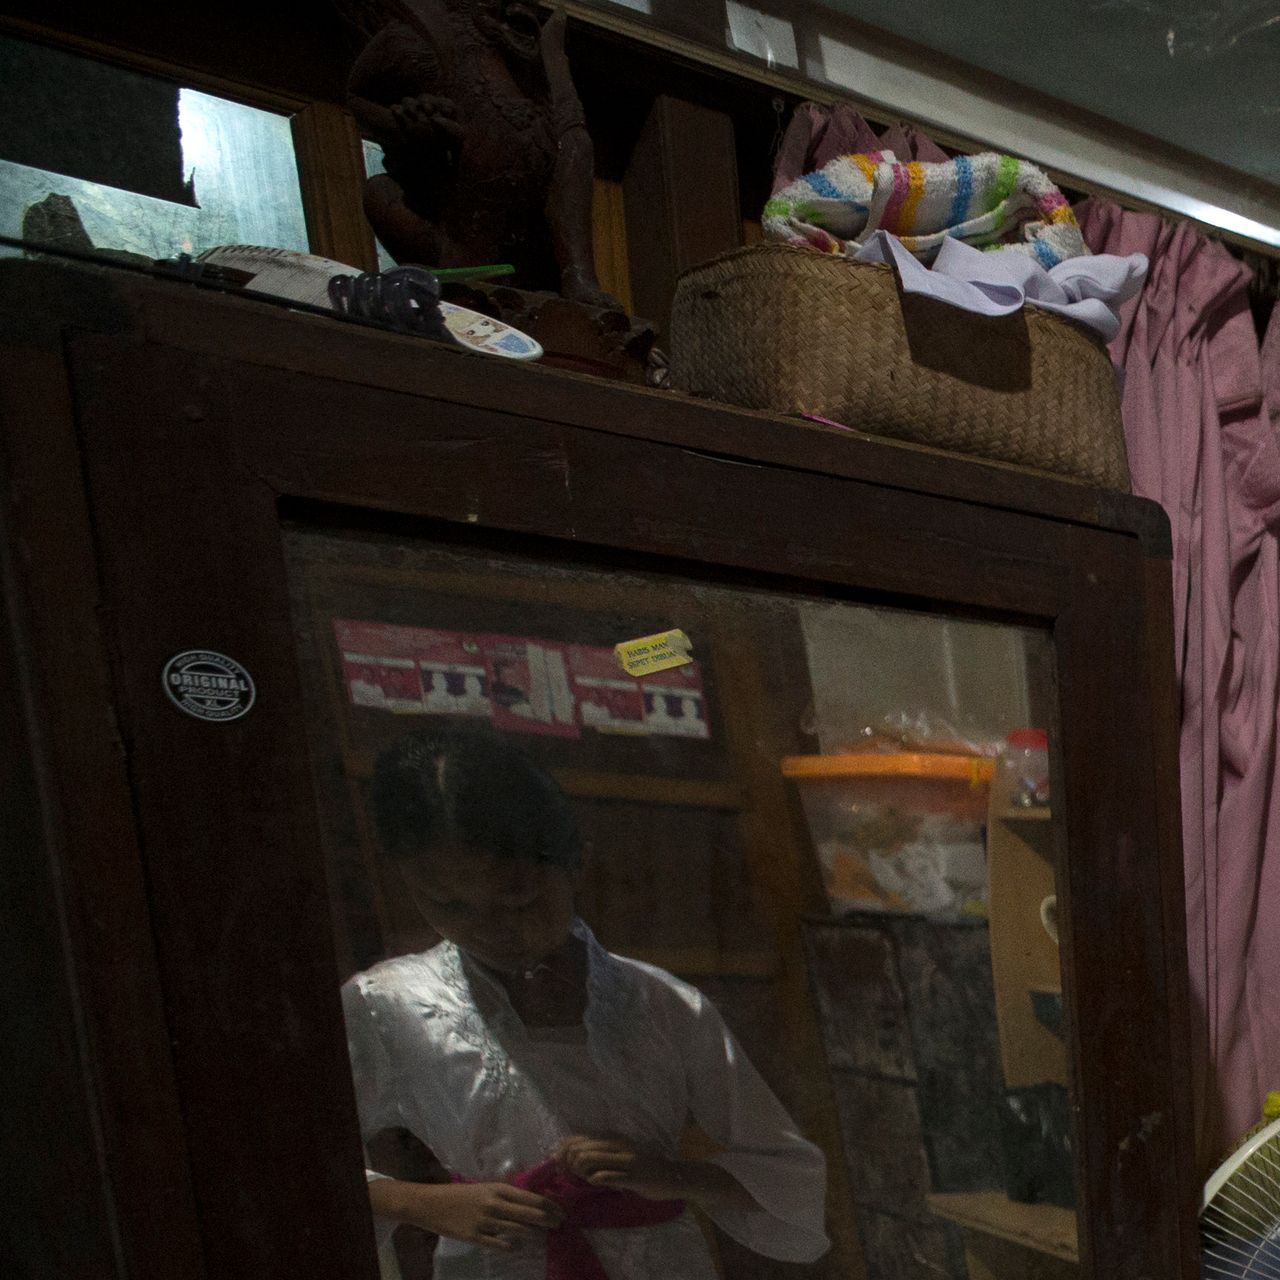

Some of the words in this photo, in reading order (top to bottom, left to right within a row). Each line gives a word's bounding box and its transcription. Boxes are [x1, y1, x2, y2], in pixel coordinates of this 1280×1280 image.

[175, 654, 198, 667] HIGH
[199, 653, 241, 675] QUALITY
[169, 673, 249, 691] ORIGINAL
[178, 685, 240, 698] PRODUCT
